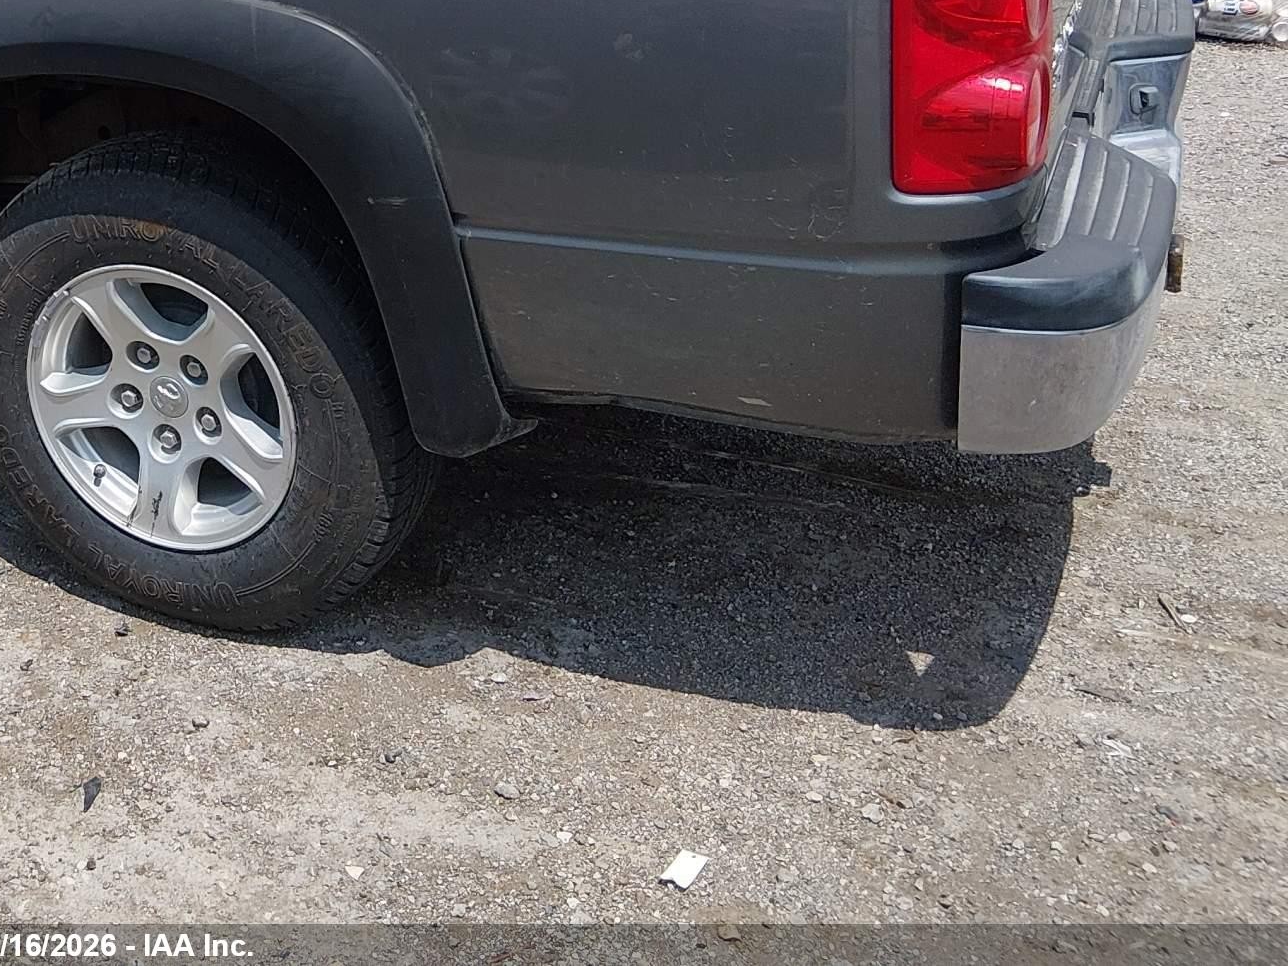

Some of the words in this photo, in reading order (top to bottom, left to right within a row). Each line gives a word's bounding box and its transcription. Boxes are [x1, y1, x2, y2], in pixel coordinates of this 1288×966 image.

[71, 220, 220, 271] UNIROYAL
[230, 265, 337, 399] LAREDO
[88, 542, 241, 606] UNIROYAL
